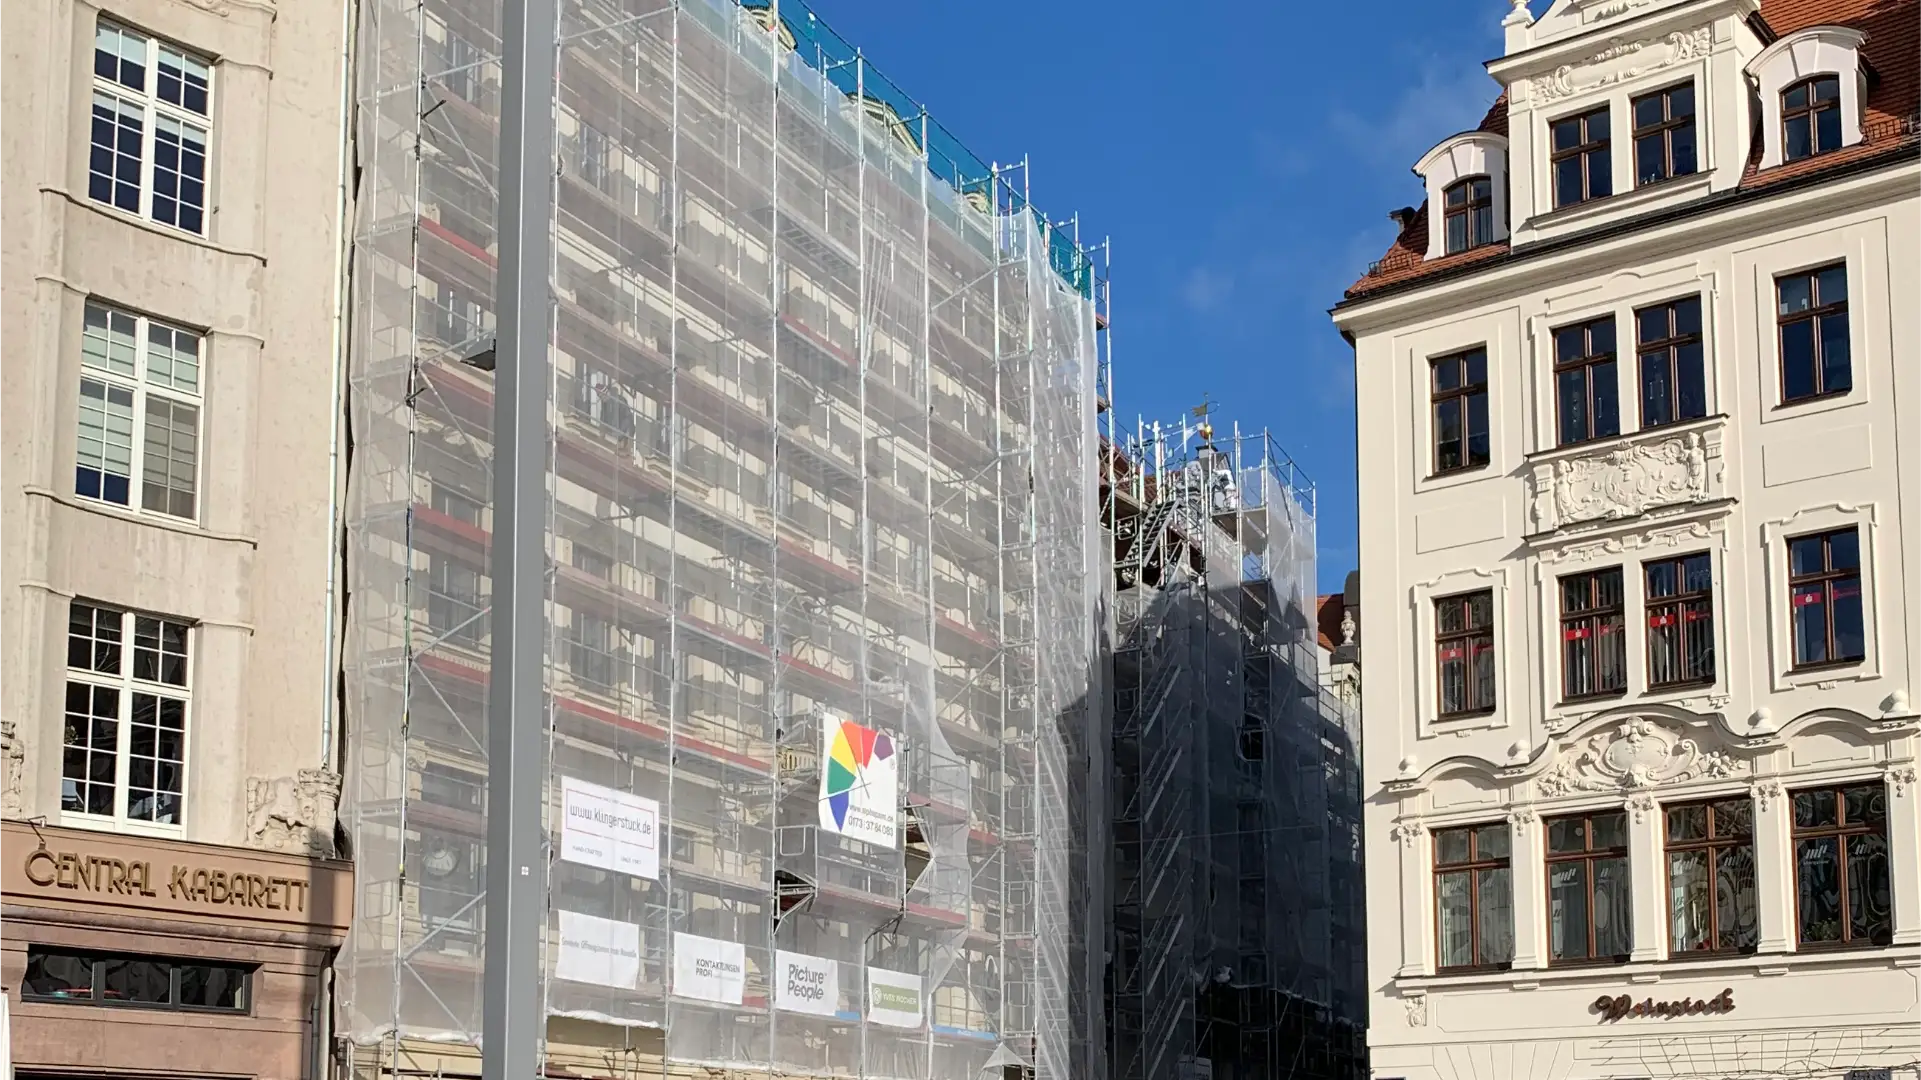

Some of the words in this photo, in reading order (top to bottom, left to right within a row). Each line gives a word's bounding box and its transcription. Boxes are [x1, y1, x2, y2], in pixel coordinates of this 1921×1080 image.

[570, 804, 651, 836] www.klingerstuck.de
[24, 850, 157, 897] CENTRAL
[168, 864, 311, 912] KABARETT
[696, 967, 712, 977] PROFI
[789, 963, 824, 984] Picture
[788, 979, 824, 1002] People
[1593, 988, 1736, 1020] Weinstock
